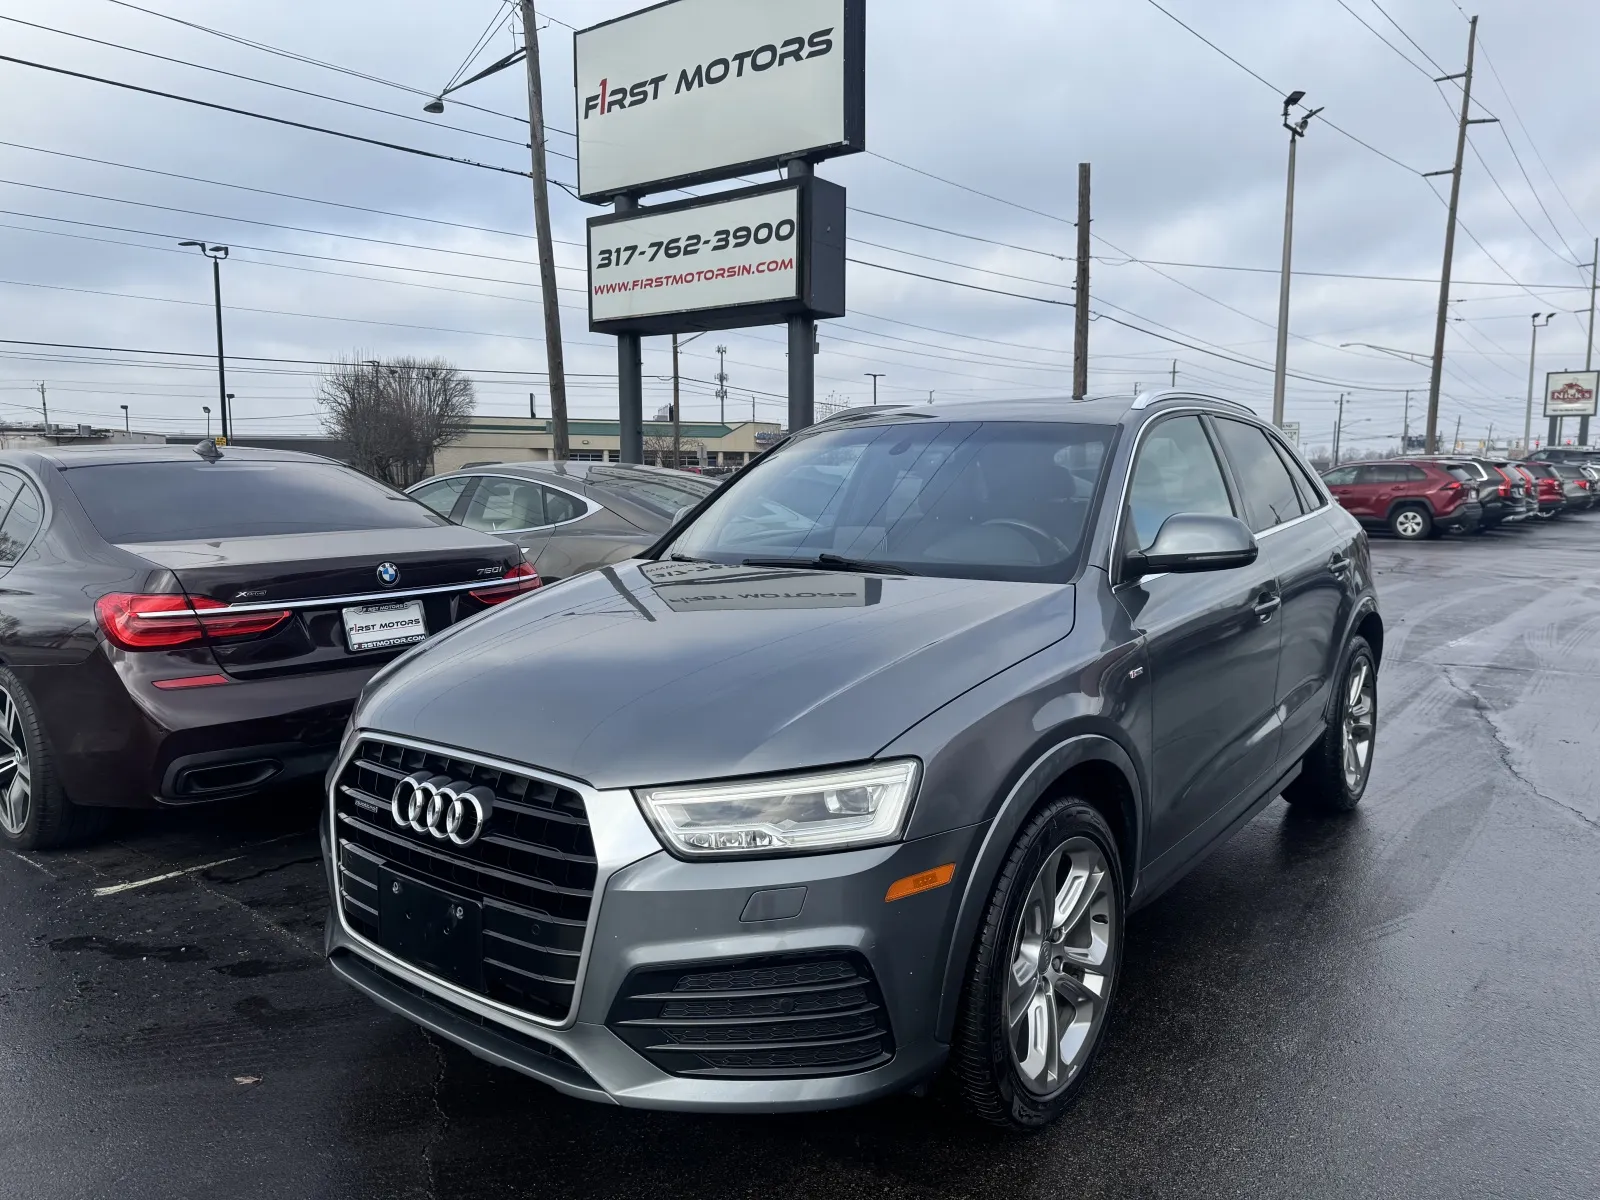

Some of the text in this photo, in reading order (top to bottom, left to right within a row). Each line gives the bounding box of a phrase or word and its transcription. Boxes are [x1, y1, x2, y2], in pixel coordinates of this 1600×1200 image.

[674, 27, 834, 94] MOTORS
[596, 218, 795, 269] 317-762-3900
[593, 258, 793, 295] WWW.FIRSTMOTORSIN.COM
[379, 618, 420, 630] MOTORS
